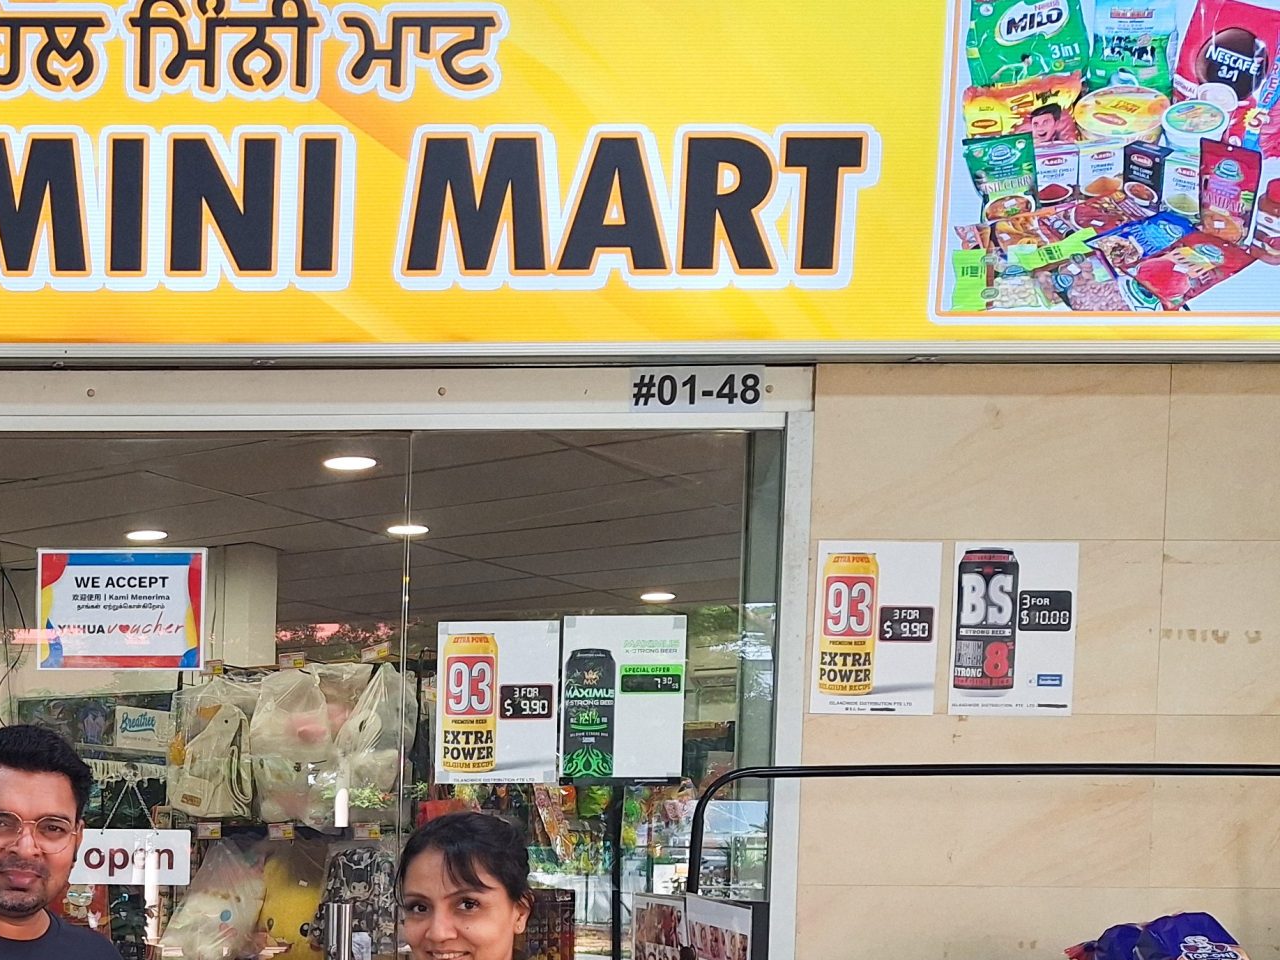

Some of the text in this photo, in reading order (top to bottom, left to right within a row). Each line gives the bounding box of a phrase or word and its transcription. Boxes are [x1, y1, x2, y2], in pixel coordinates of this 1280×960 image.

[1006, 7, 1063, 36] MILO
[343, 15, 498, 87] ਮਾਟ
[402, 133, 868, 274] MART
[631, 373, 762, 407] #01-48
[74, 576, 170, 589] WE ACCEPT
[108, 593, 171, 601] Kami Menerima
[1021, 594, 1051, 609] 3 FOR
[826, 581, 873, 634] 93
[893, 609, 920, 620] 3 FOR
[1020, 610, 1070, 626] $ 10.00
[883, 620, 929, 639] $ 9.90
[820, 651, 872, 667] EXTRA
[983, 641, 1010, 679] 8
[819, 668, 871, 683] POWER
[954, 667, 983, 678] STRONG
[448, 661, 493, 713] 93
[513, 687, 539, 698] 3 FOR
[565, 688, 615, 699] MAXIMUS
[504, 698, 549, 717] $ 9.90
[443, 730, 494, 745] EXTRA
[443, 745, 494, 761] POWER
[82, 844, 176, 878] open
